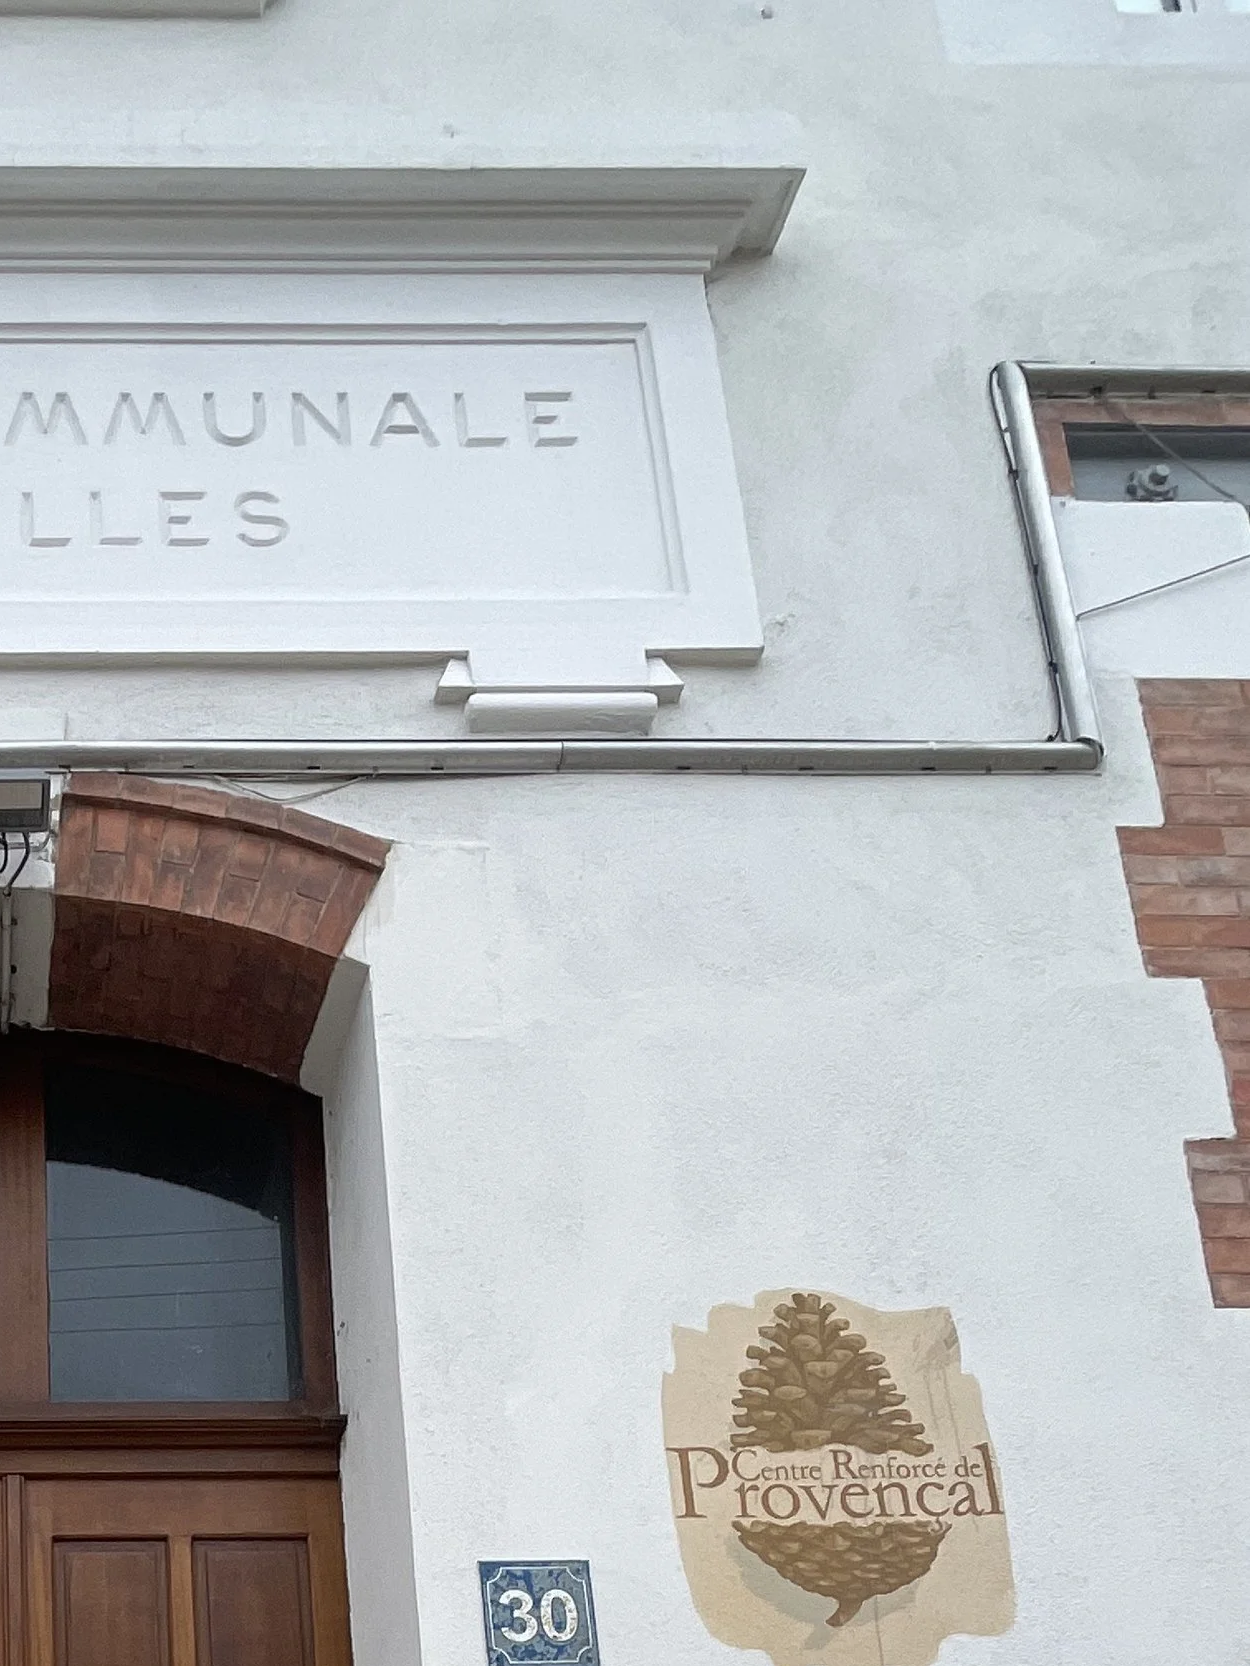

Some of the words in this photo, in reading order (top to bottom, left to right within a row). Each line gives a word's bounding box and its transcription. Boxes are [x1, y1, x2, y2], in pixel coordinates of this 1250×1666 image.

[665, 1442, 1004, 1534] Provençal
[731, 1449, 821, 1483] Centre
[828, 1449, 948, 1480] Renforcé
[954, 1455, 984, 1479] de
[499, 1589, 579, 1642] 30
